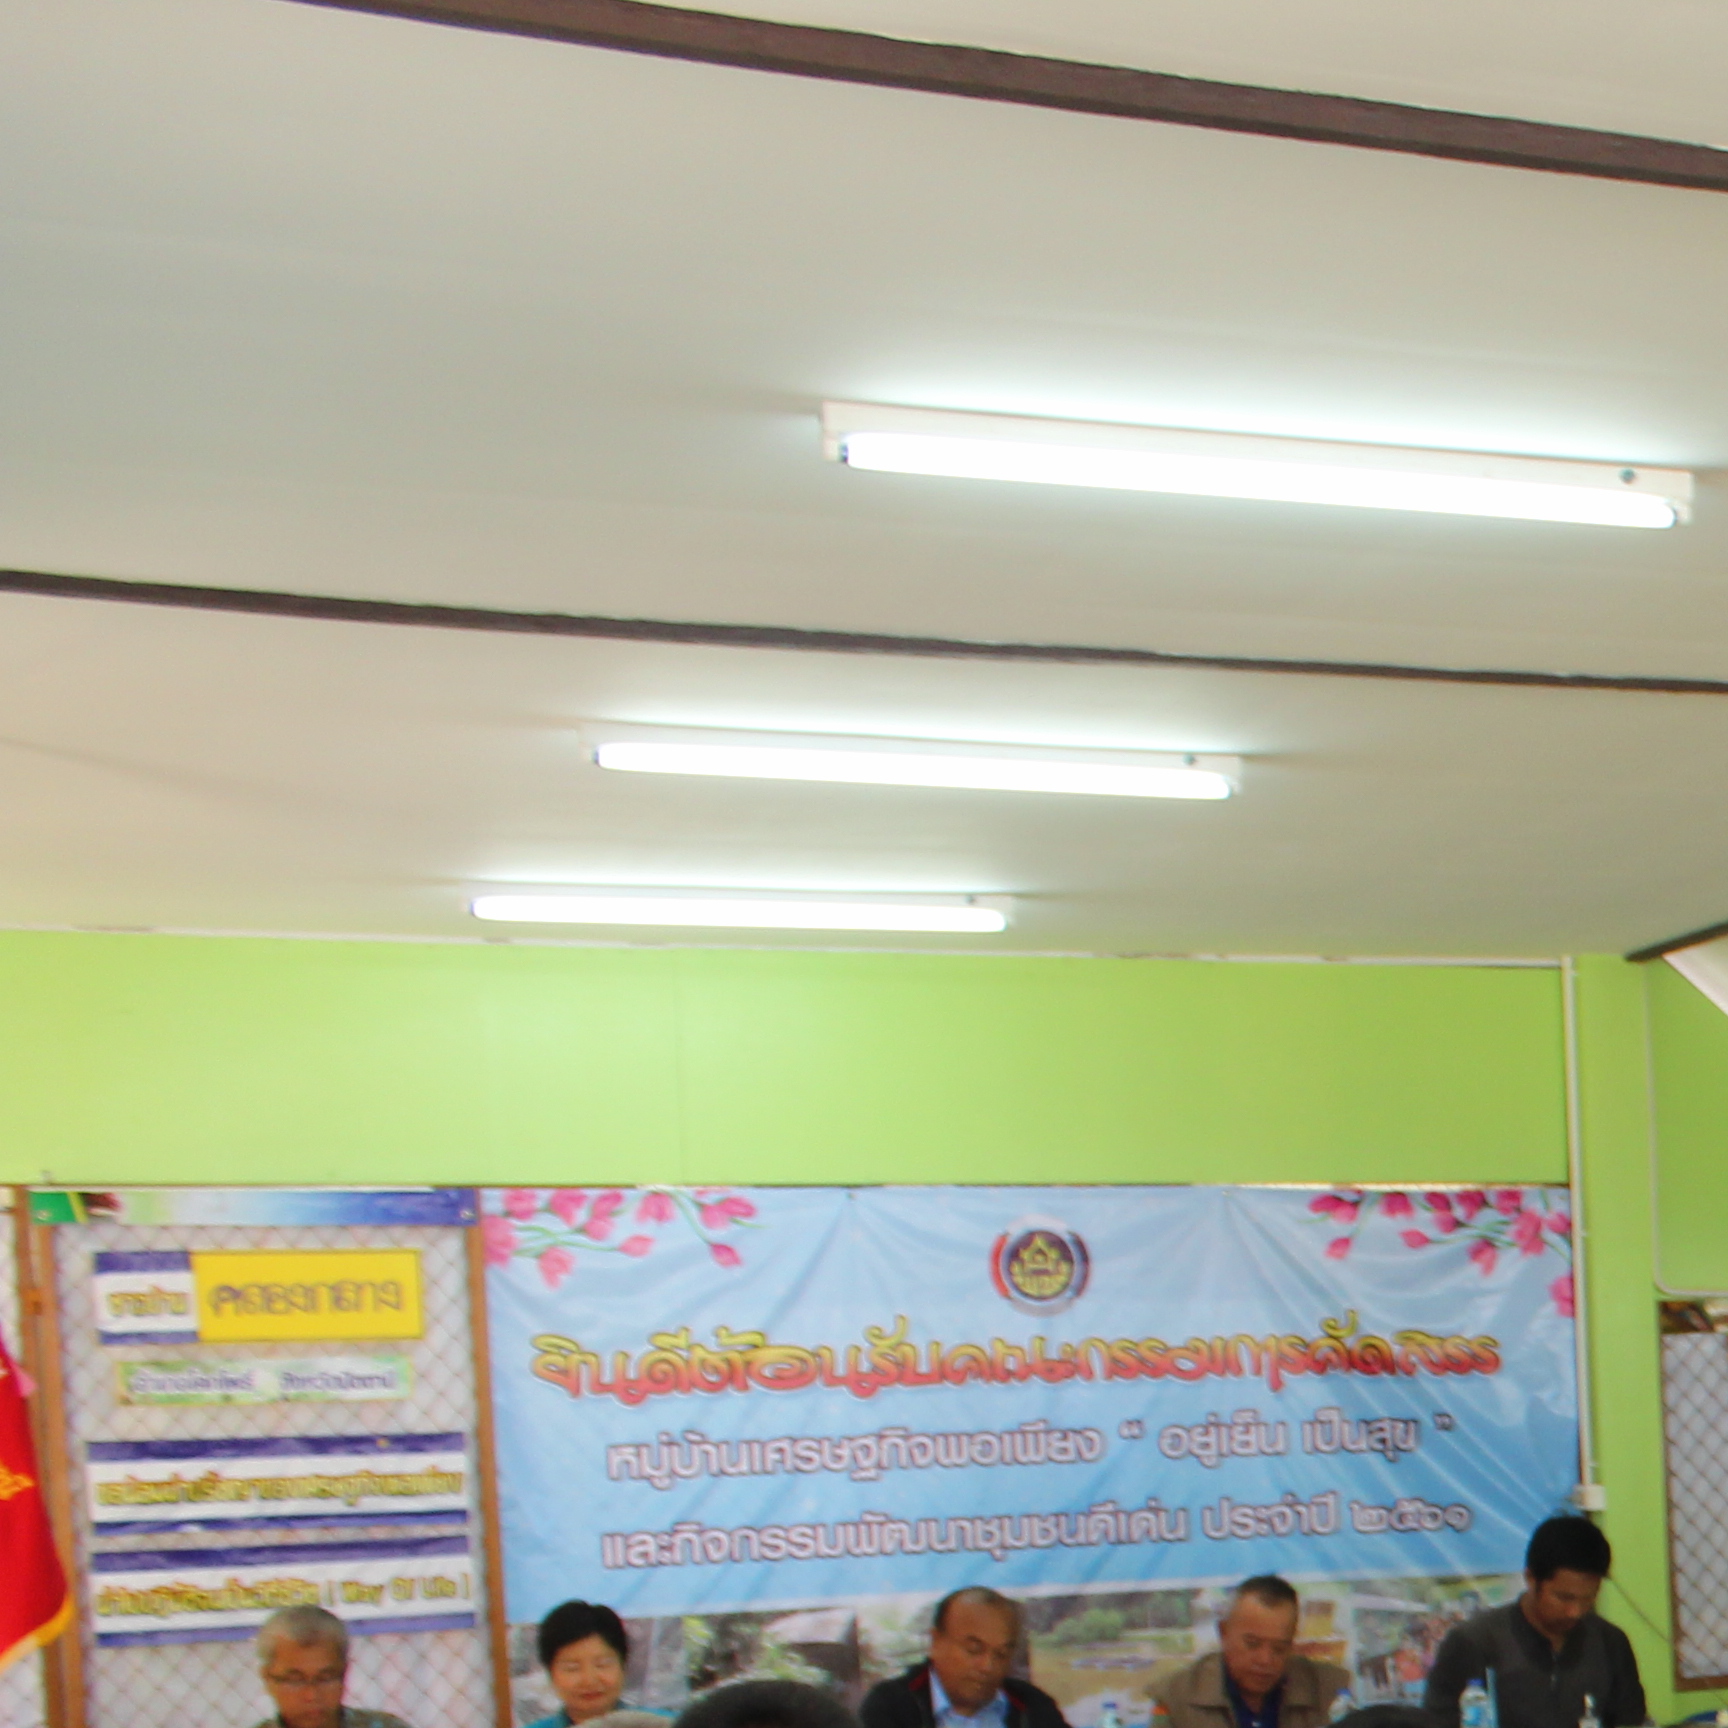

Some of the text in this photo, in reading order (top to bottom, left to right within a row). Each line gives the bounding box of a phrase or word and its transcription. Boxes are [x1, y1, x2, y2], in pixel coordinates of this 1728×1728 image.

[606, 1419, 1104, 1491] หมู่บ้านเศรษฐกิจพอเพียง
[1158, 1408, 1287, 1468] อยู่เย็น
[1302, 1407, 1420, 1463] เป็นสุข
[602, 1491, 1473, 1570] และกิจกรรมพัฒนาชุมชนดีเด่น ประจำปี ๒๕๖๑
